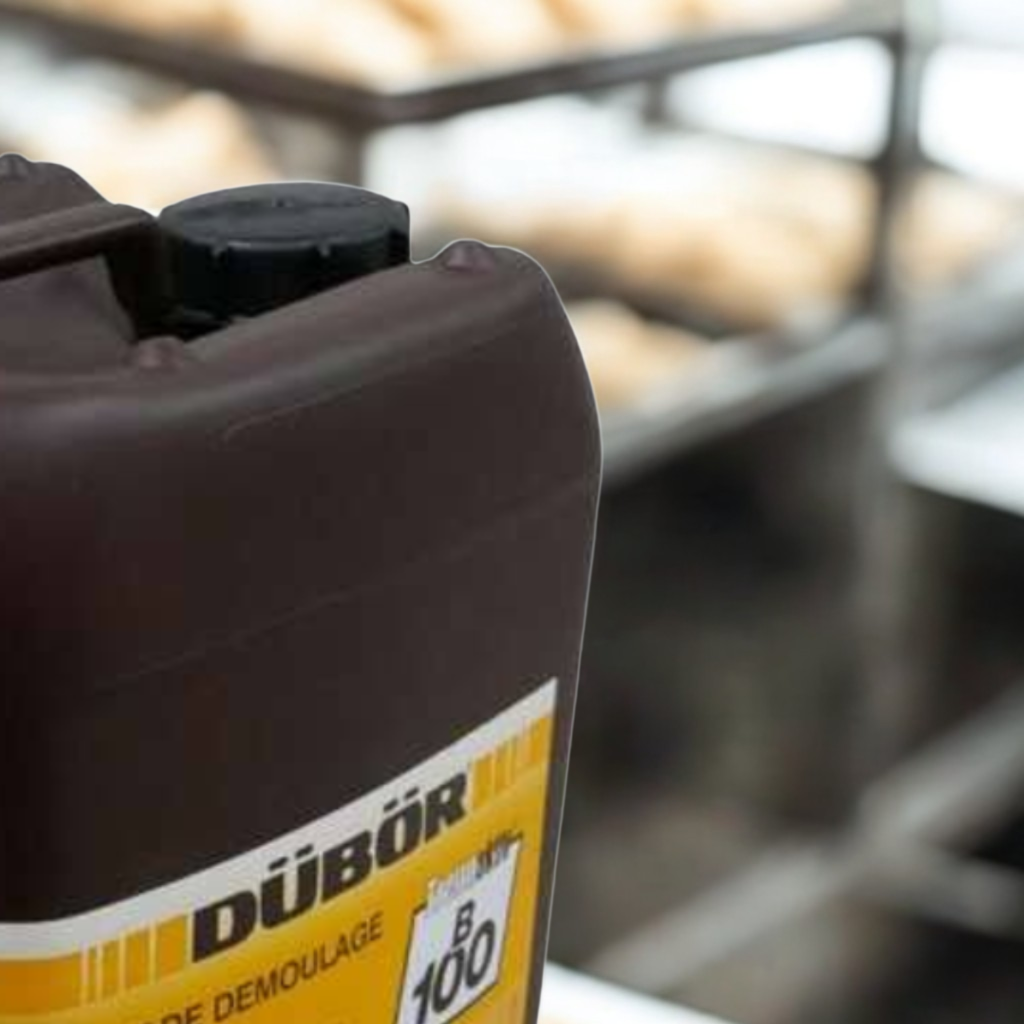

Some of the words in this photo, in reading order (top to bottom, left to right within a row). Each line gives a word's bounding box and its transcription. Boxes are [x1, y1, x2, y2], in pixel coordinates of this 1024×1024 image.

[190, 771, 467, 964] DÜBÖR
[452, 899, 475, 949] B
[213, 910, 384, 1023] DEMOULAGE
